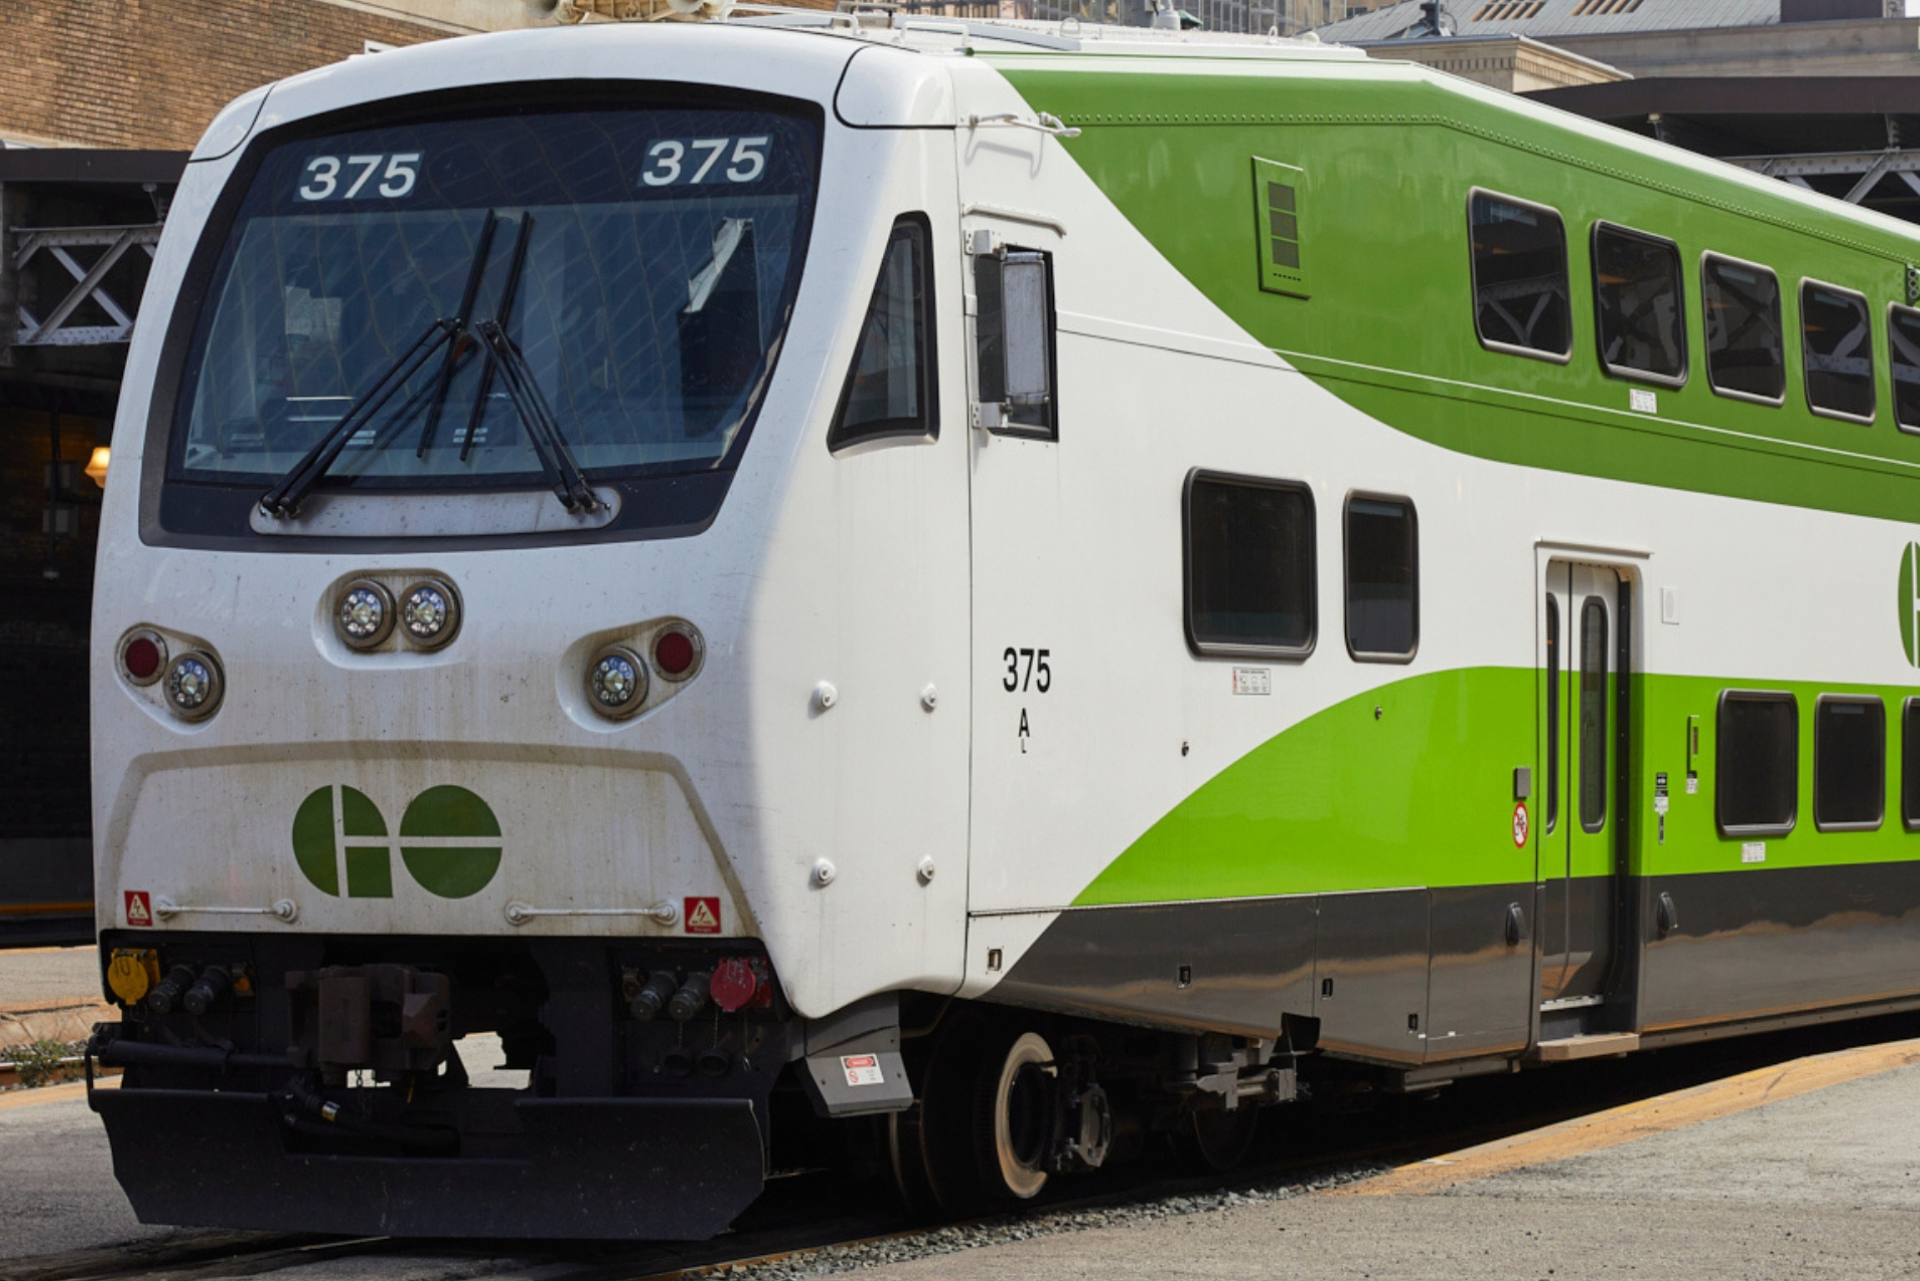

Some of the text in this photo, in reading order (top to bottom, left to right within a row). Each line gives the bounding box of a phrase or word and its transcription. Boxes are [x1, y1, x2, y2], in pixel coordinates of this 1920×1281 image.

[300, 153, 420, 200] 375
[643, 137, 768, 186] 375
[1002, 646, 1051, 693] 375
[1018, 707, 1030, 738] A
[292, 784, 503, 899] GO
